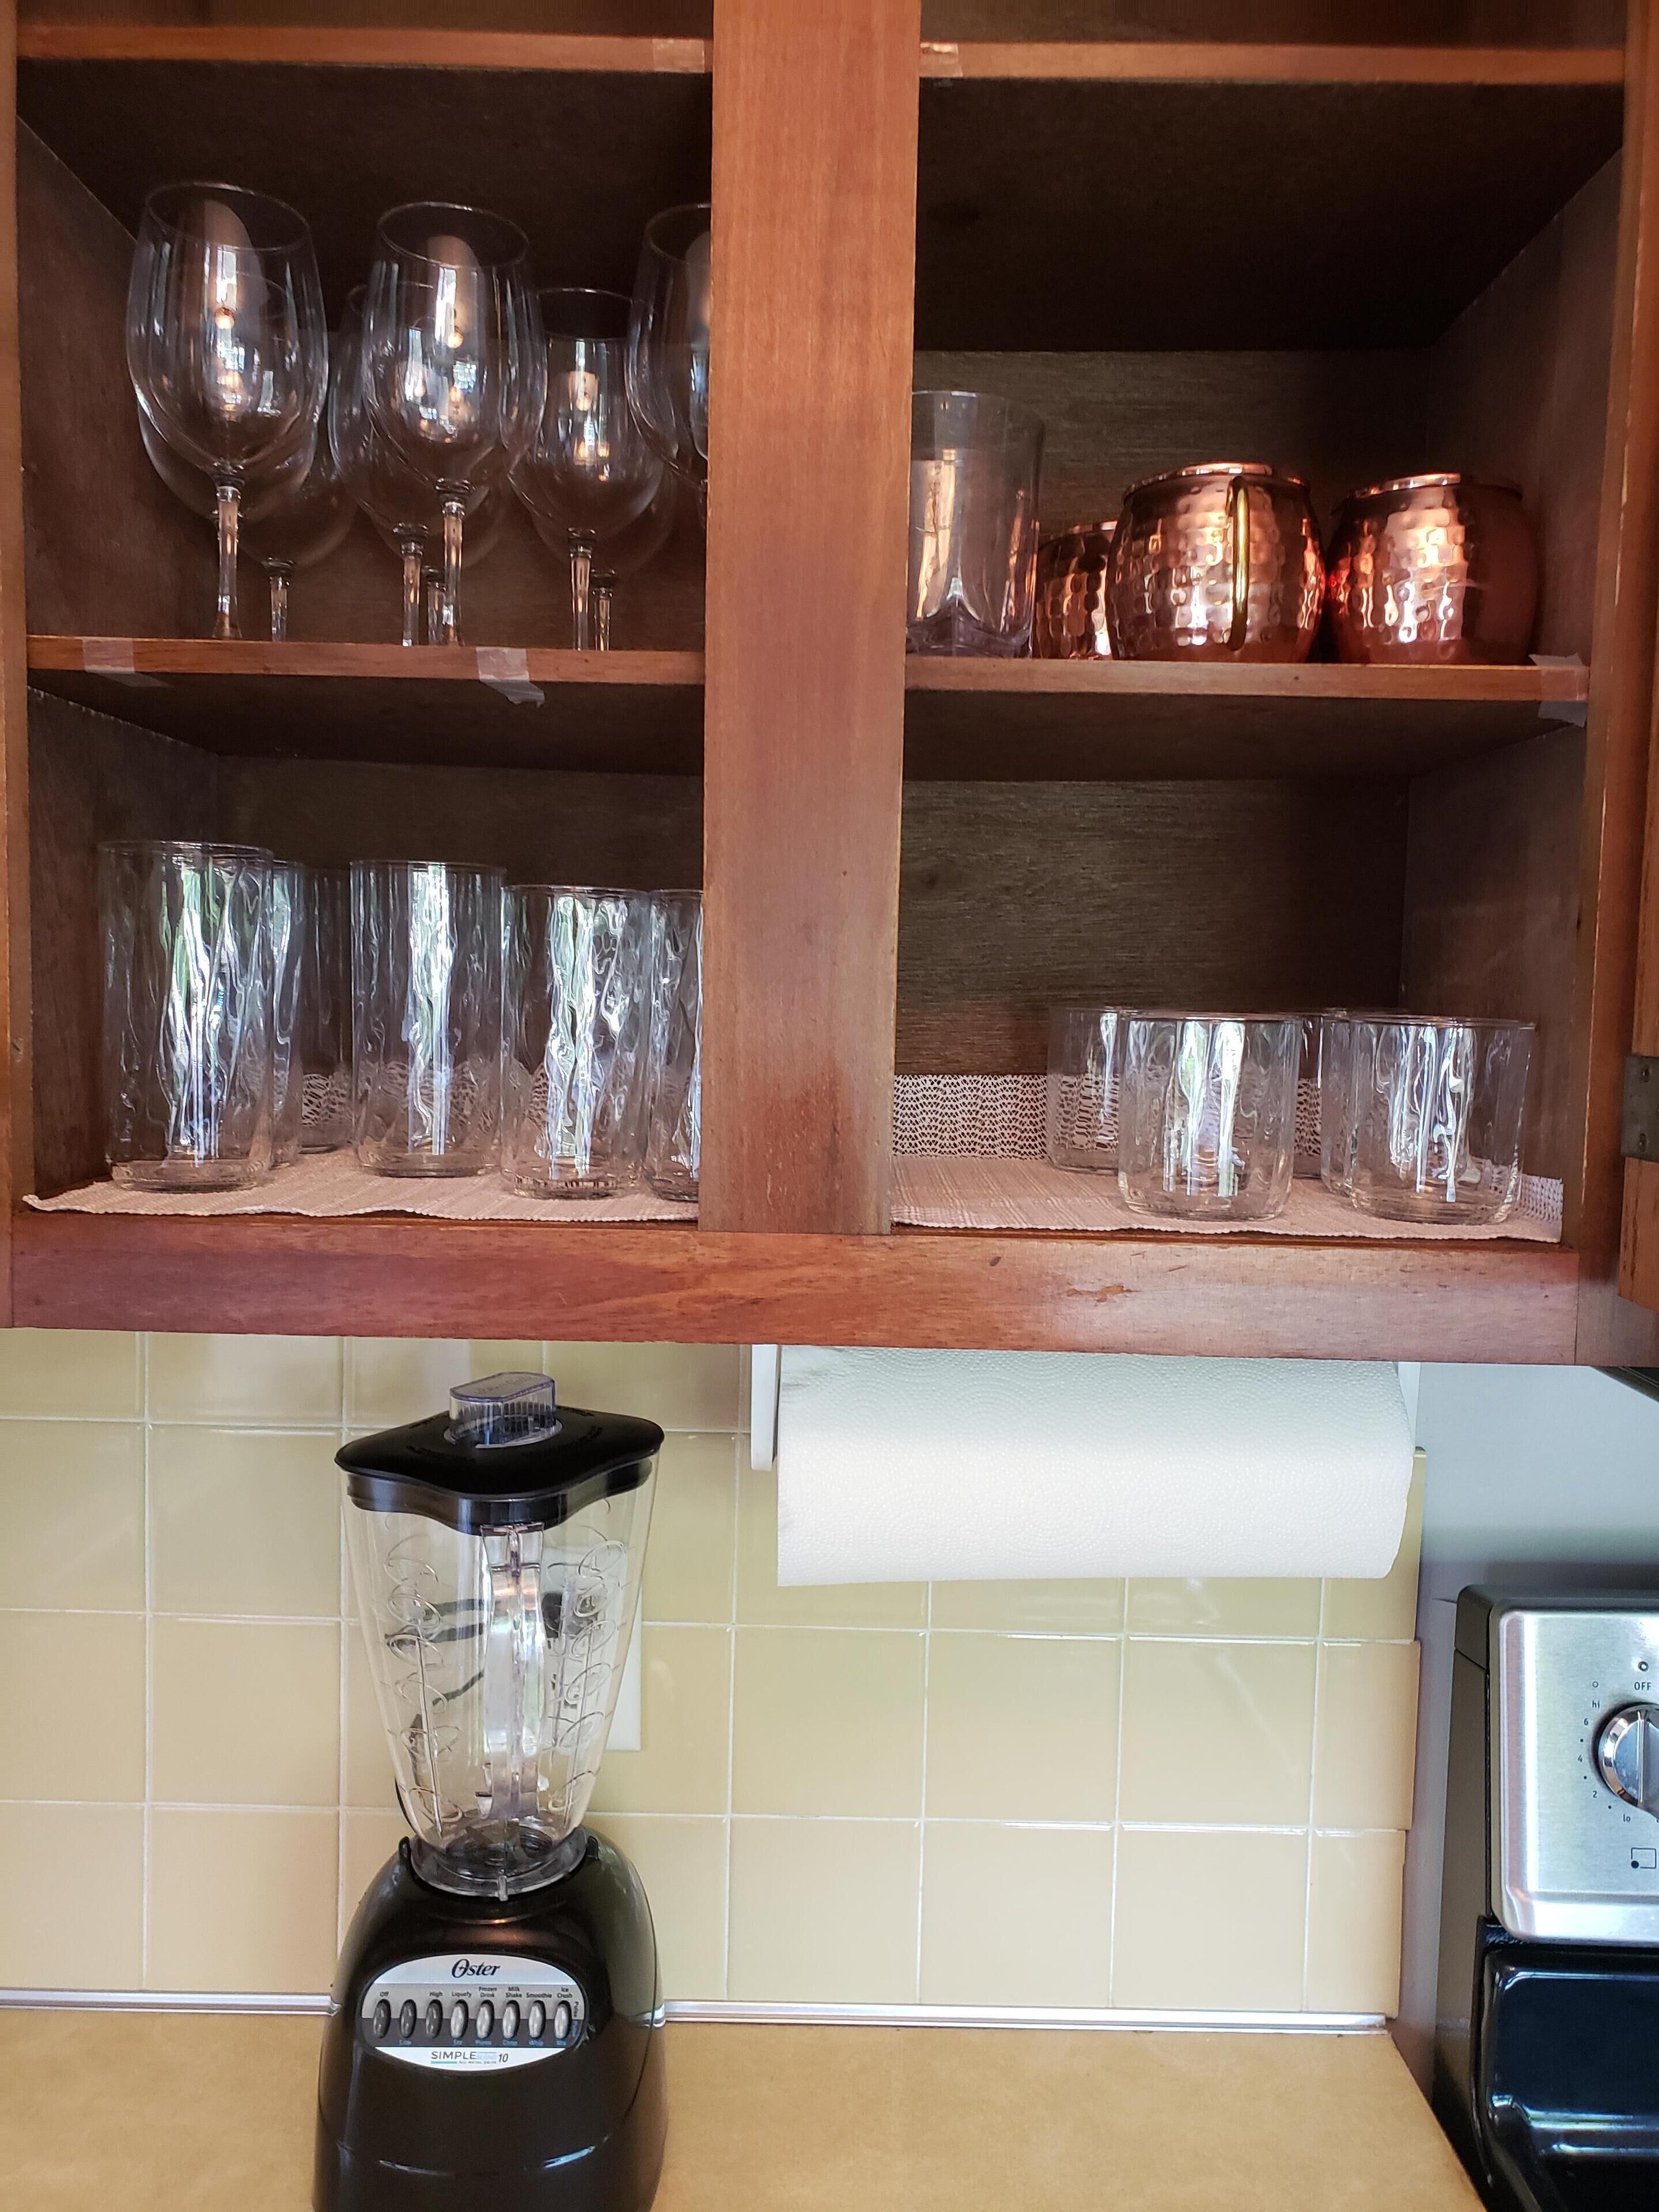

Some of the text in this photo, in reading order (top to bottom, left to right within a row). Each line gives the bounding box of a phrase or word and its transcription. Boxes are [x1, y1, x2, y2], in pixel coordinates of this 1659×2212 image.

[1634, 1681, 1652, 1691] OFF
[1592, 1700, 1600, 1709] hi
[1584, 1718, 1589, 1726] 6
[1578, 1755, 1583, 1763] 4
[1623, 1815, 1631, 1823] lo
[452, 1959, 501, 1978] Oster
[498, 2053, 509, 2063] 10
